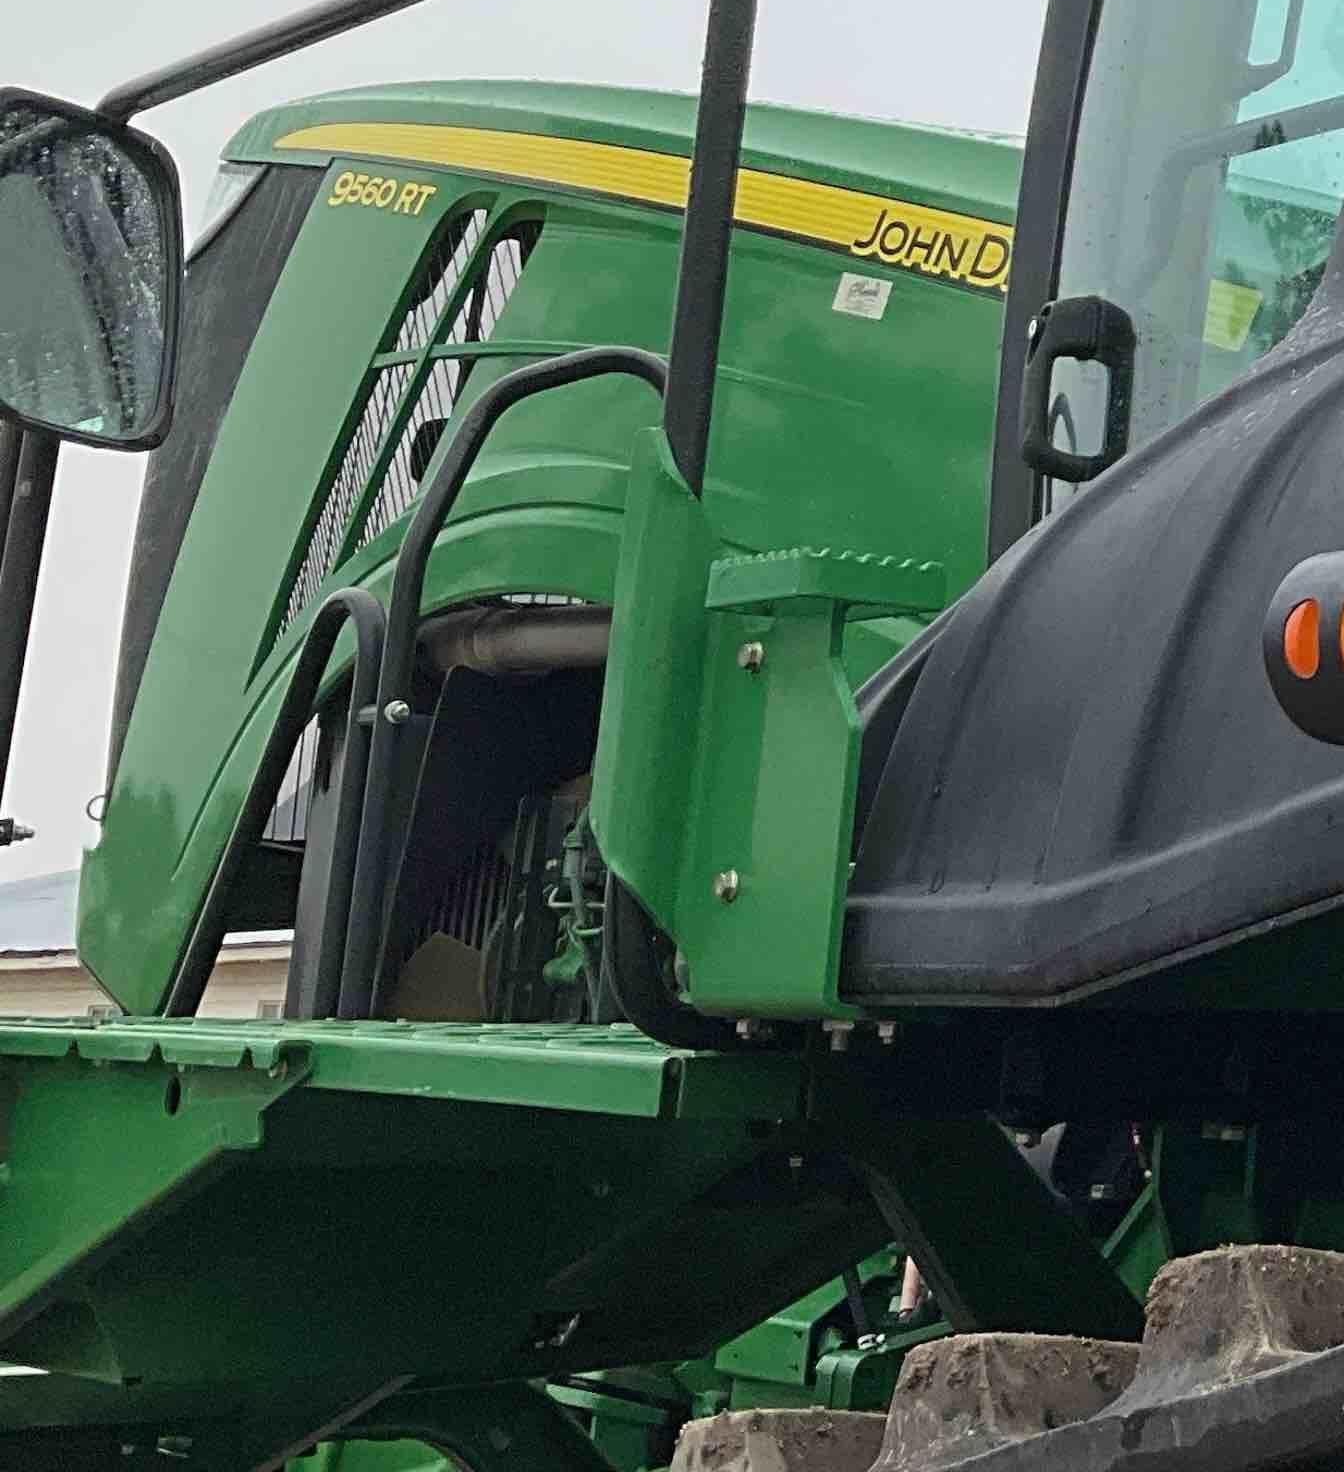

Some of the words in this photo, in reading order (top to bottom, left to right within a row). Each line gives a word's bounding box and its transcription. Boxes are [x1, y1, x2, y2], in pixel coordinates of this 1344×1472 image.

[328, 171, 398, 207] 9560
[393, 181, 438, 216] RT
[851, 209, 968, 278] JOHN
